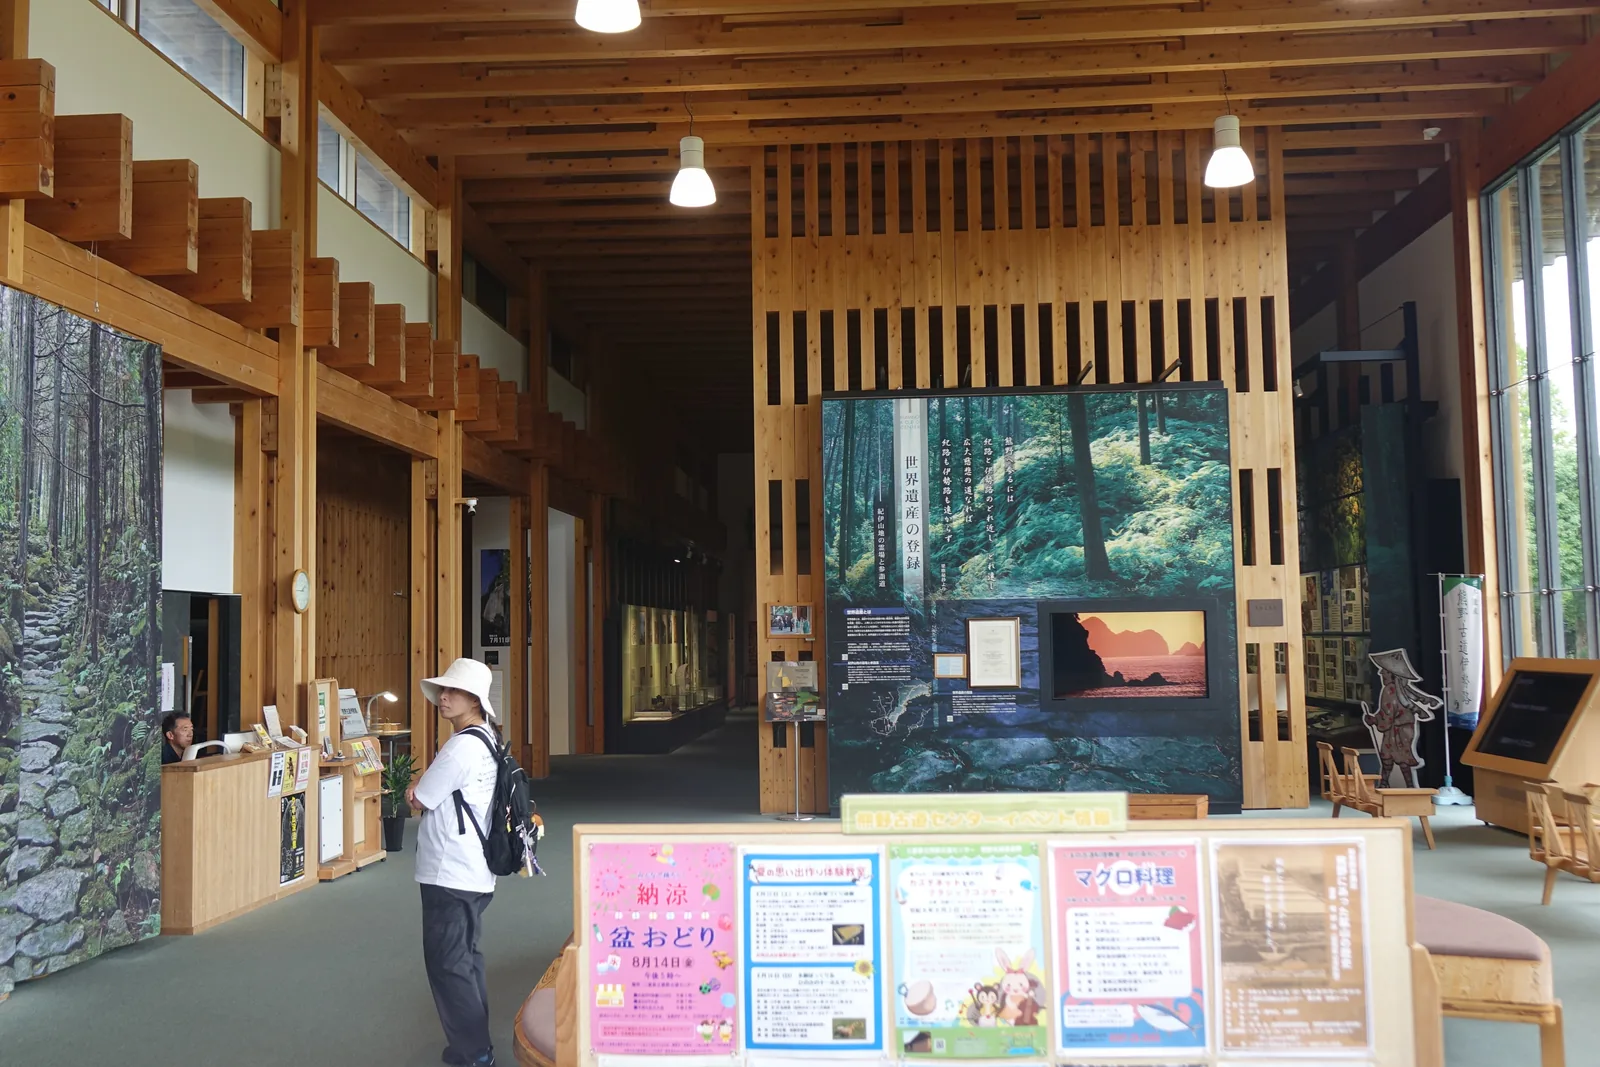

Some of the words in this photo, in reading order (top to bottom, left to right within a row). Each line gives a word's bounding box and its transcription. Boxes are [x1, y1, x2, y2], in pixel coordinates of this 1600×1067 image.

[905, 455, 921, 570] 世界遺産の登録
[941, 438, 953, 543] 紀路も伊勢路も遠からず
[963, 437, 974, 523] 広大慈悲の道なれば
[877, 507, 886, 588] 紀伊山地の霊場と参詣道
[637, 882, 689, 906] 納涼
[1075, 866, 1175, 887] マグロ料理
[608, 926, 715, 949] 盆おどり
